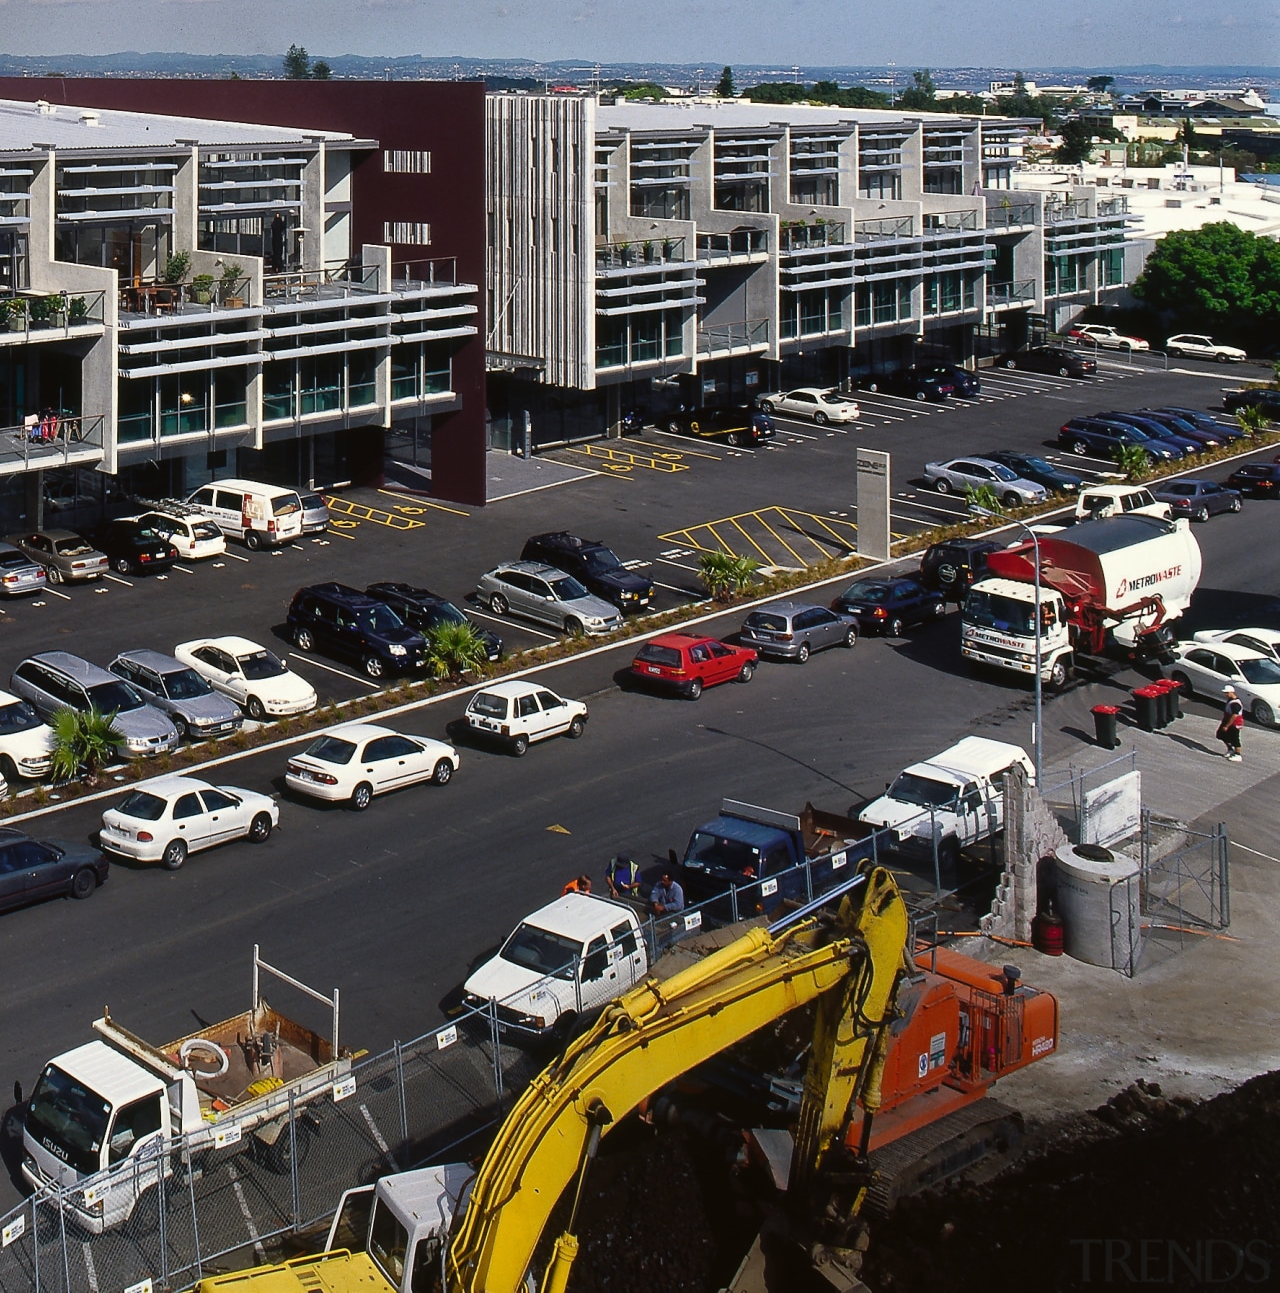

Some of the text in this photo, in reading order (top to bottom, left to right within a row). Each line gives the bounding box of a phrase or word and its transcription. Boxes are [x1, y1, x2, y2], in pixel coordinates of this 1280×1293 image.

[1128, 564, 1182, 592] METROWASTE
[975, 631, 1027, 649] METROWASTE
[42, 1136, 69, 1161] ISUZU
